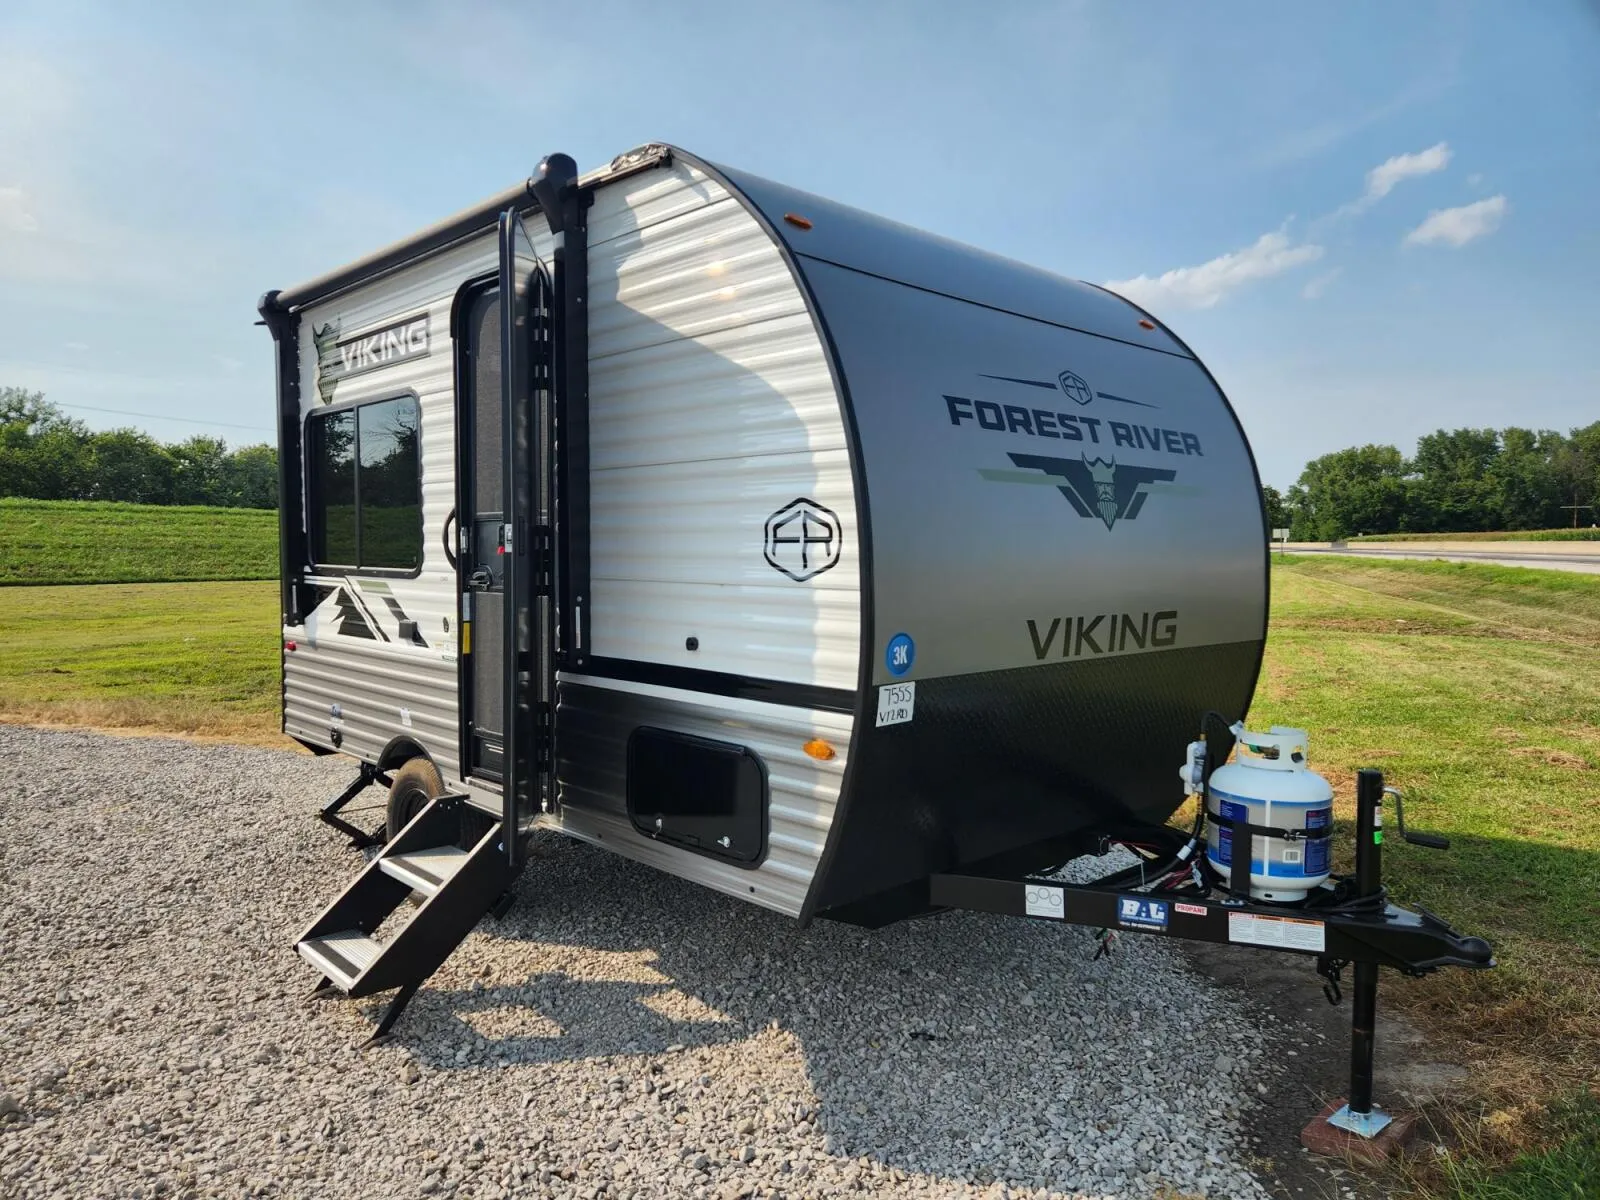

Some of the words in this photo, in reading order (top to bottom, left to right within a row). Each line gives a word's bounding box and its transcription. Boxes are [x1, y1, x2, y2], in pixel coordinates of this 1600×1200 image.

[340, 319, 428, 372] VIKING
[942, 394, 1101, 443] FOREST
[1107, 420, 1204, 456] RIVER
[892, 644, 908, 665] 3K
[1026, 610, 1178, 660] VIKING
